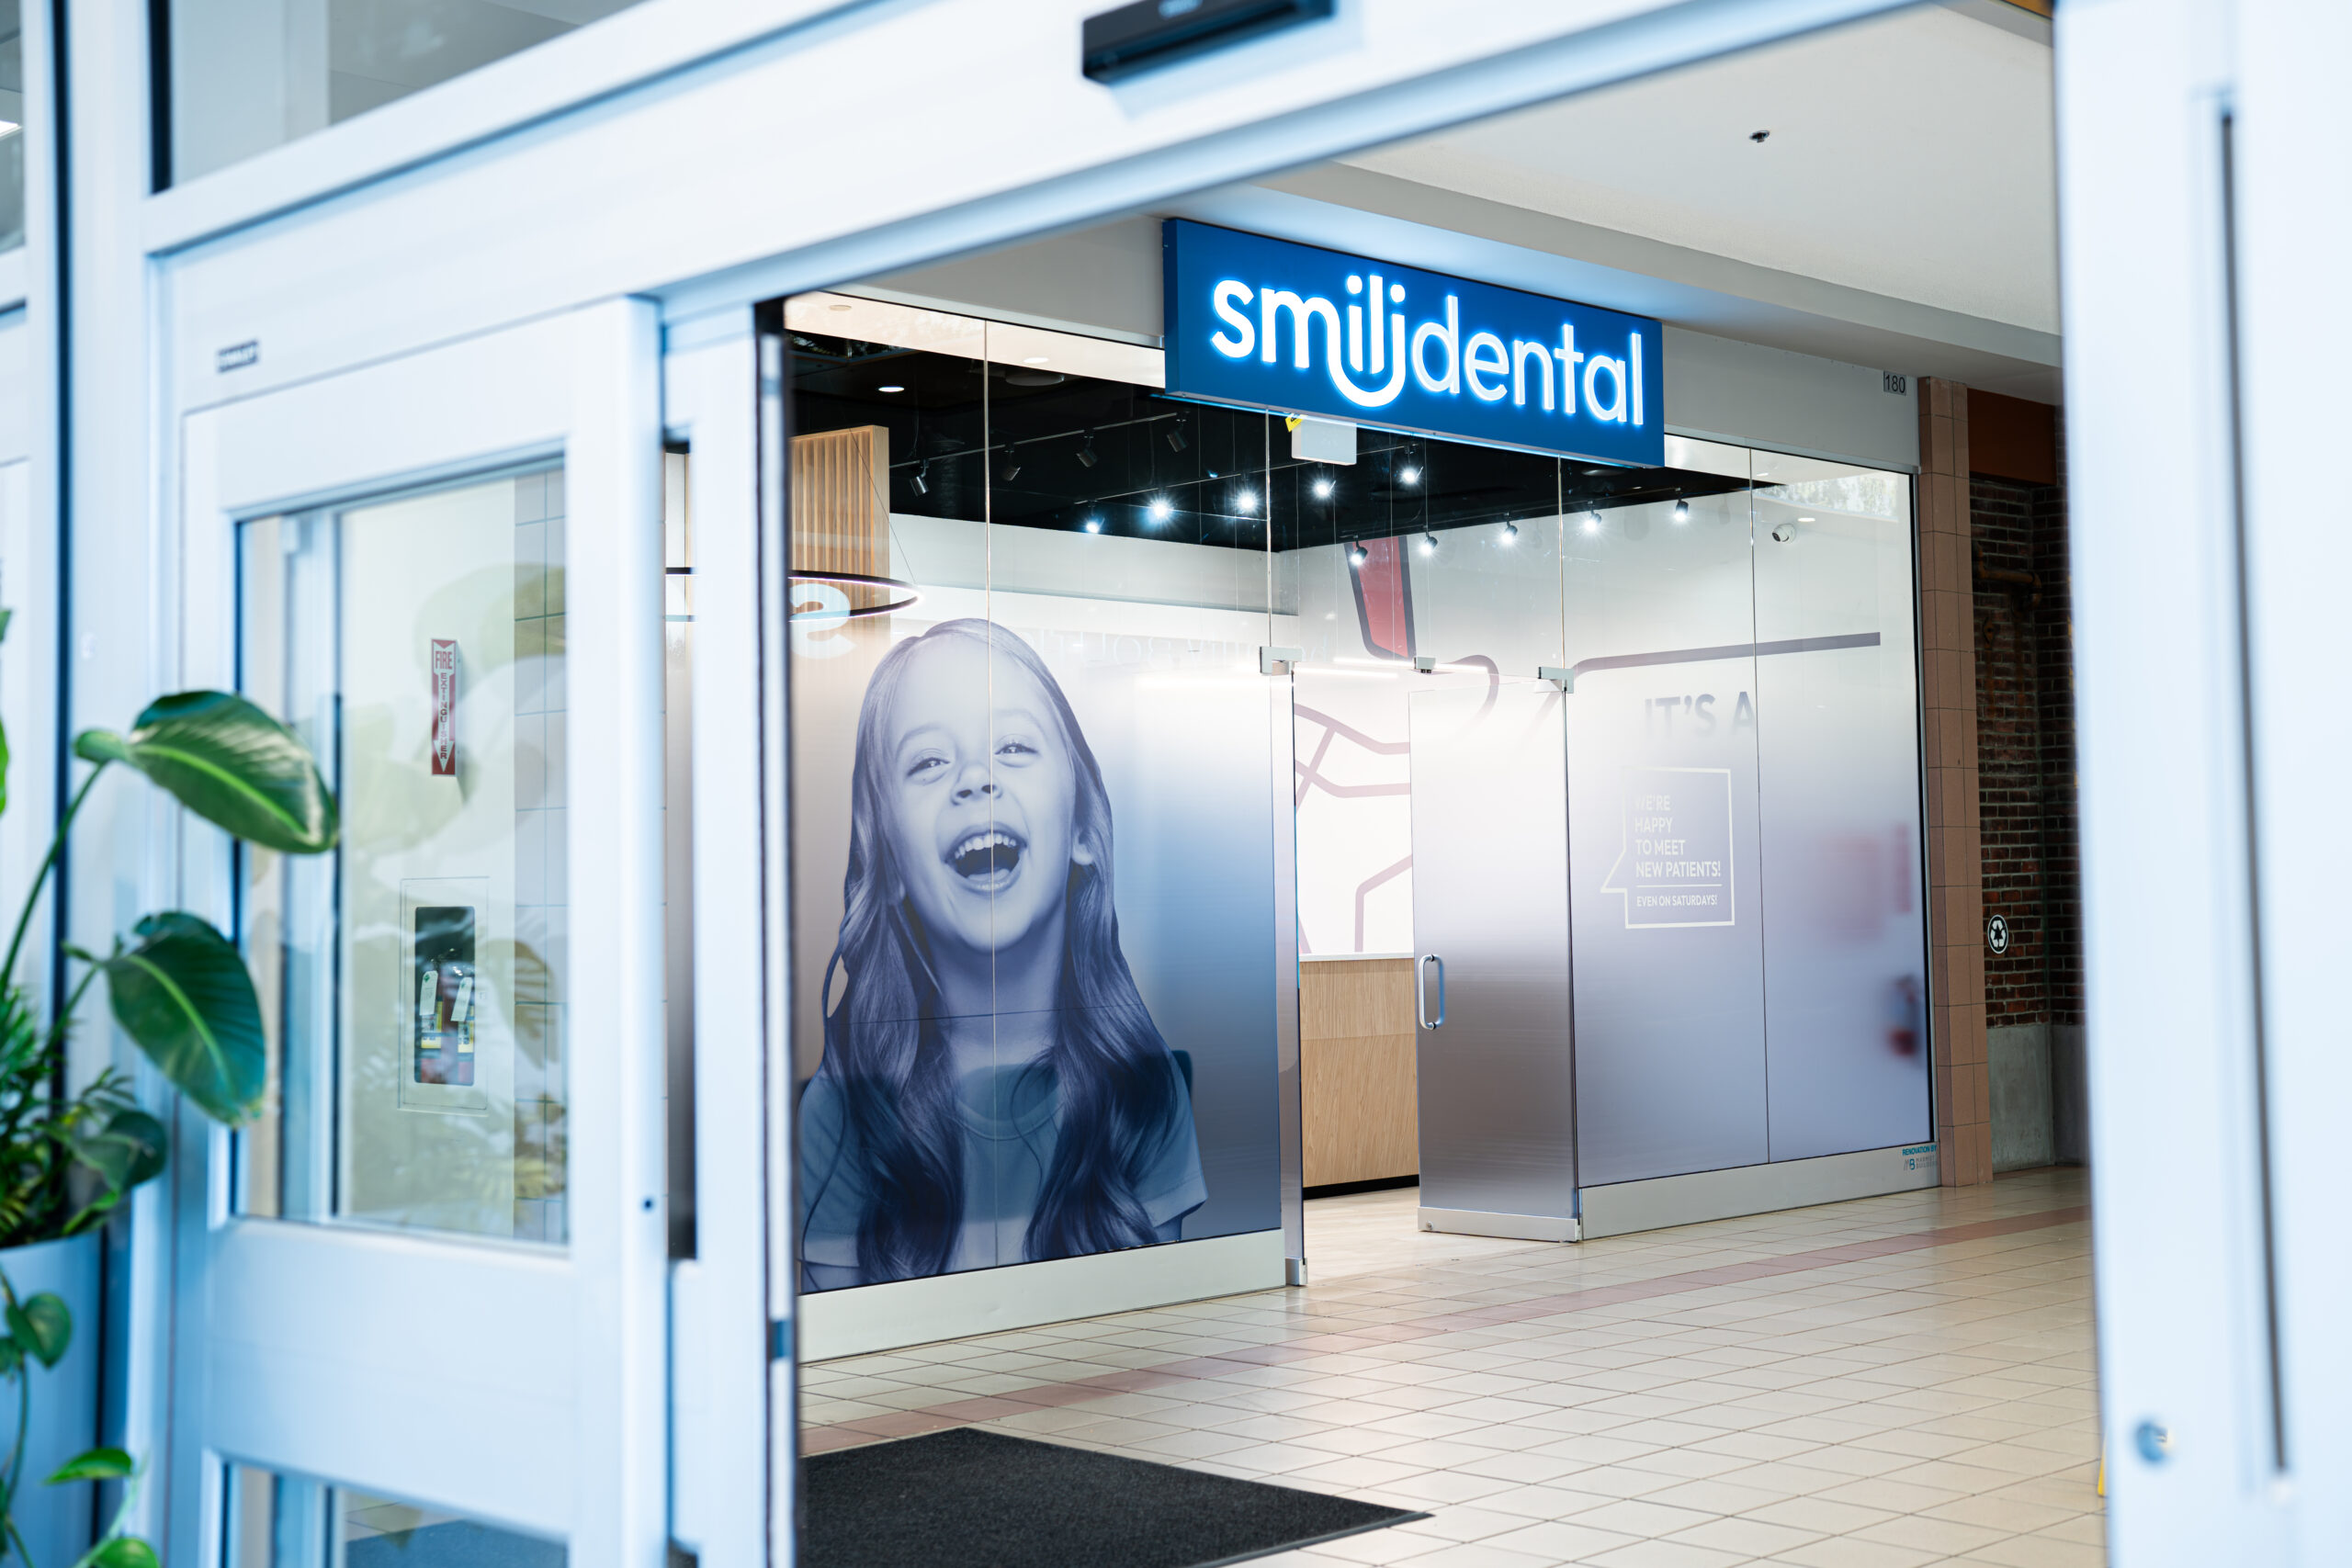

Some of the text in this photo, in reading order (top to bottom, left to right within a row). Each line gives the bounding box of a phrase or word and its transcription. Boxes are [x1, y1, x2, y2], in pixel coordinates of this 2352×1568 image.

[1885, 374, 1905, 393] 180
[435, 650, 453, 670] FIRE
[1645, 691, 1756, 738] IT'S A
[1634, 795, 1672, 811] WE'RE
[1634, 817, 1673, 833] HAPPY
[1635, 839, 1686, 855] TO MEET
[1635, 860, 1721, 877] NEW PATIENTS!
[1636, 894, 1718, 907] EVEN ON SATURDAYS!
[1902, 1145, 1937, 1156] RENOVATION BY
